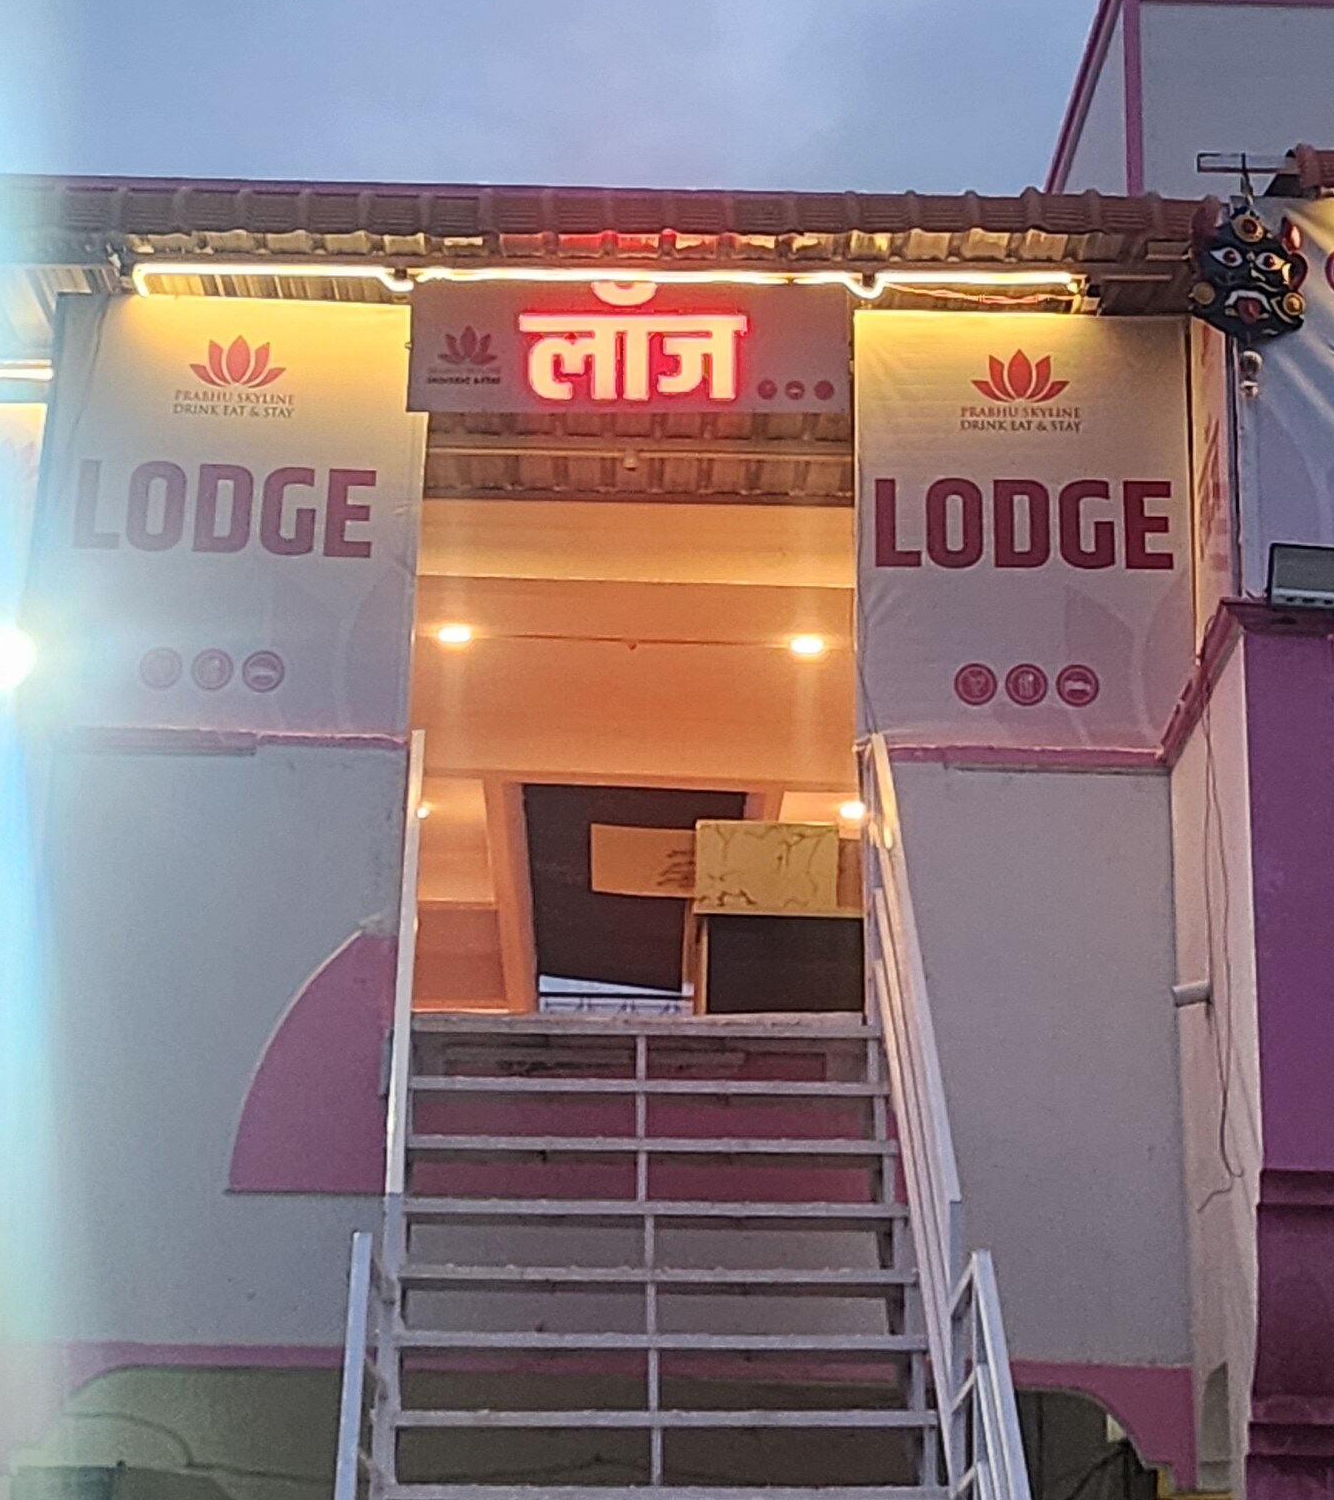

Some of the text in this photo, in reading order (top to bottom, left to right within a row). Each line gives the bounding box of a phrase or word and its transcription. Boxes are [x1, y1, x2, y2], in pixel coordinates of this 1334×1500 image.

[518, 282, 748, 400] लॉज
[174, 389, 295, 406] PRABHU SKYLINE
[173, 403, 295, 419] DRINK EAT & STAY
[960, 406, 1081, 420] PRABHU SKYLINE
[960, 419, 1083, 434] DRINK EAT & STAY
[72, 459, 377, 559] LODGE
[873, 477, 1175, 571] LODGE
